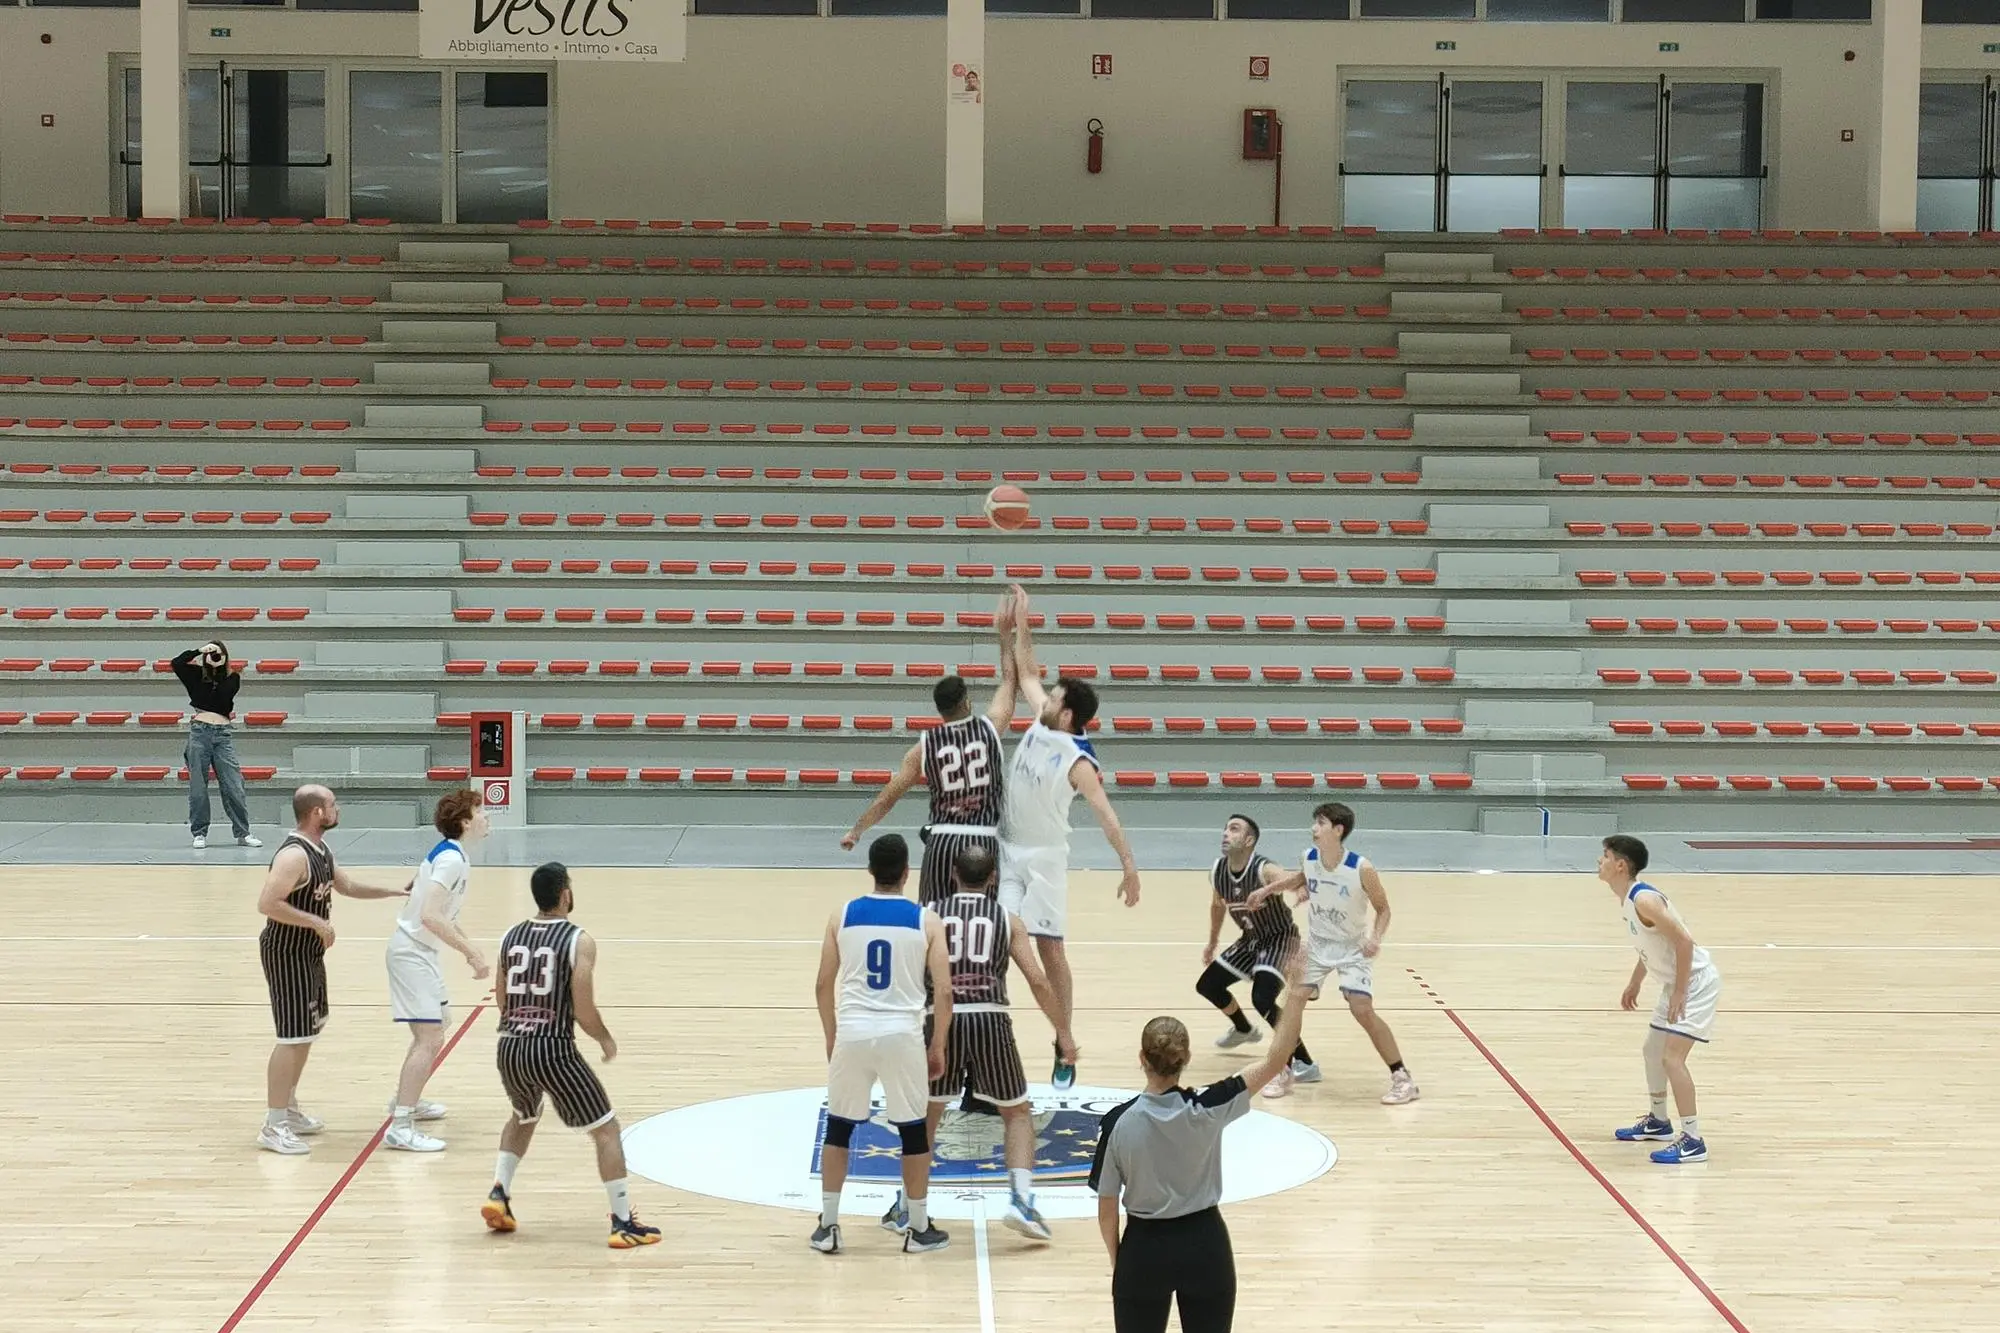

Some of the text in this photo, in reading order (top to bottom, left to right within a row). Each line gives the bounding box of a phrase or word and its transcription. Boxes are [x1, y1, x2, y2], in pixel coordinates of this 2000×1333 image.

[448, 39, 658, 55] Abbigliamento Intimo Casa
[937, 740, 990, 792] 22
[866, 939, 892, 990] 9
[943, 916, 993, 963] 30
[506, 945, 554, 995] 23
